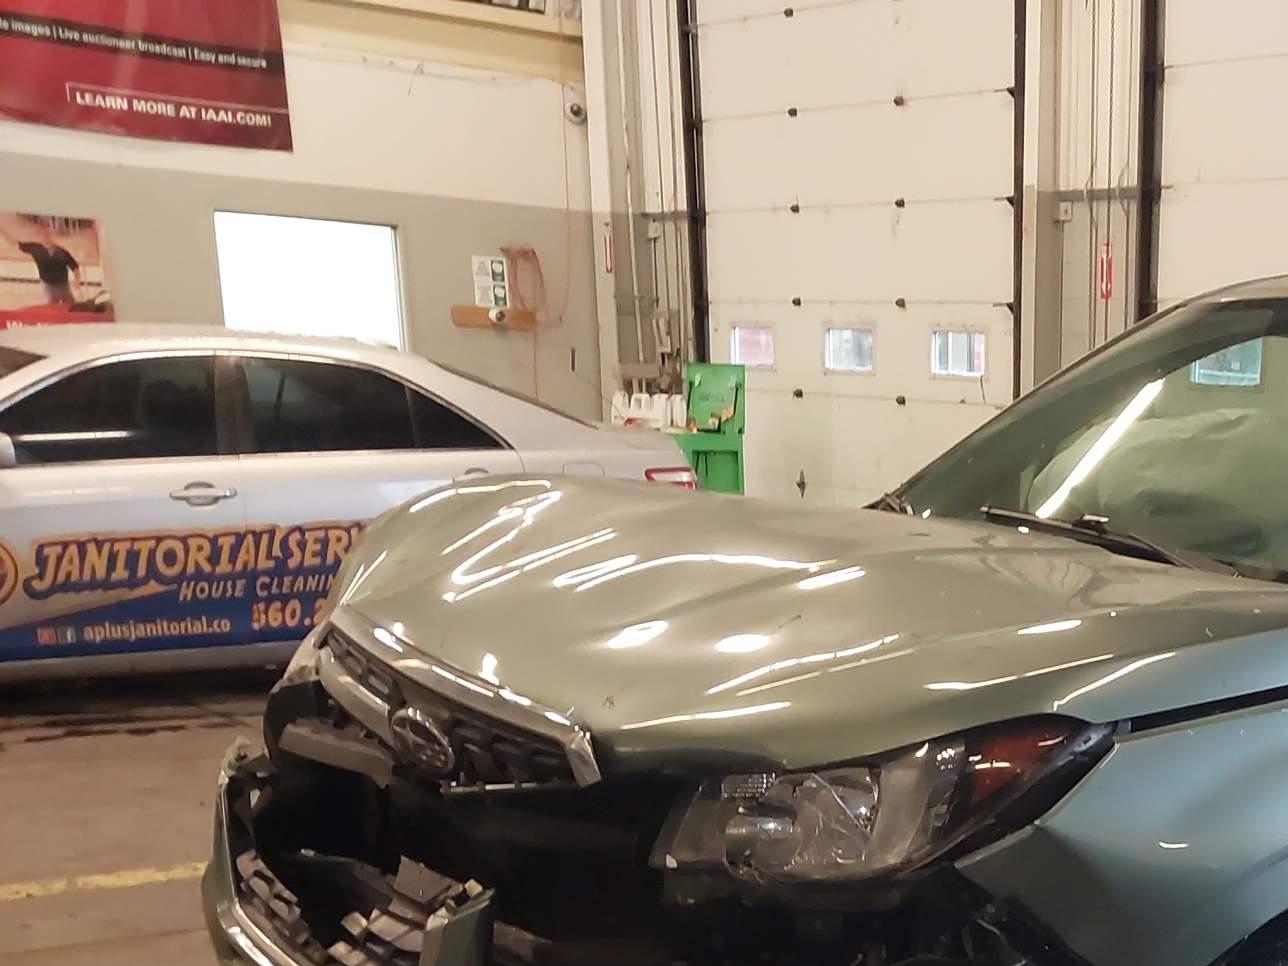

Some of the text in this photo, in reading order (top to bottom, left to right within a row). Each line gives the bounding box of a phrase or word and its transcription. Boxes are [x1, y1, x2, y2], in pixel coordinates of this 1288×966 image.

[11, 19, 52, 37] images
[59, 26, 80, 42] Live
[82, 31, 136, 50] auctioneer
[138, 39, 187, 59] broadcast
[193, 47, 215, 65] Easy
[218, 52, 236, 65] and
[75, 90, 128, 111] LEARN
[132, 99, 176, 118] MORE
[179, 104, 198, 120] AT
[29, 530, 277, 593] JANITORIAL
[178, 578, 247, 603] HOUSE
[83, 615, 231, 644] aplusjanitorial.co
